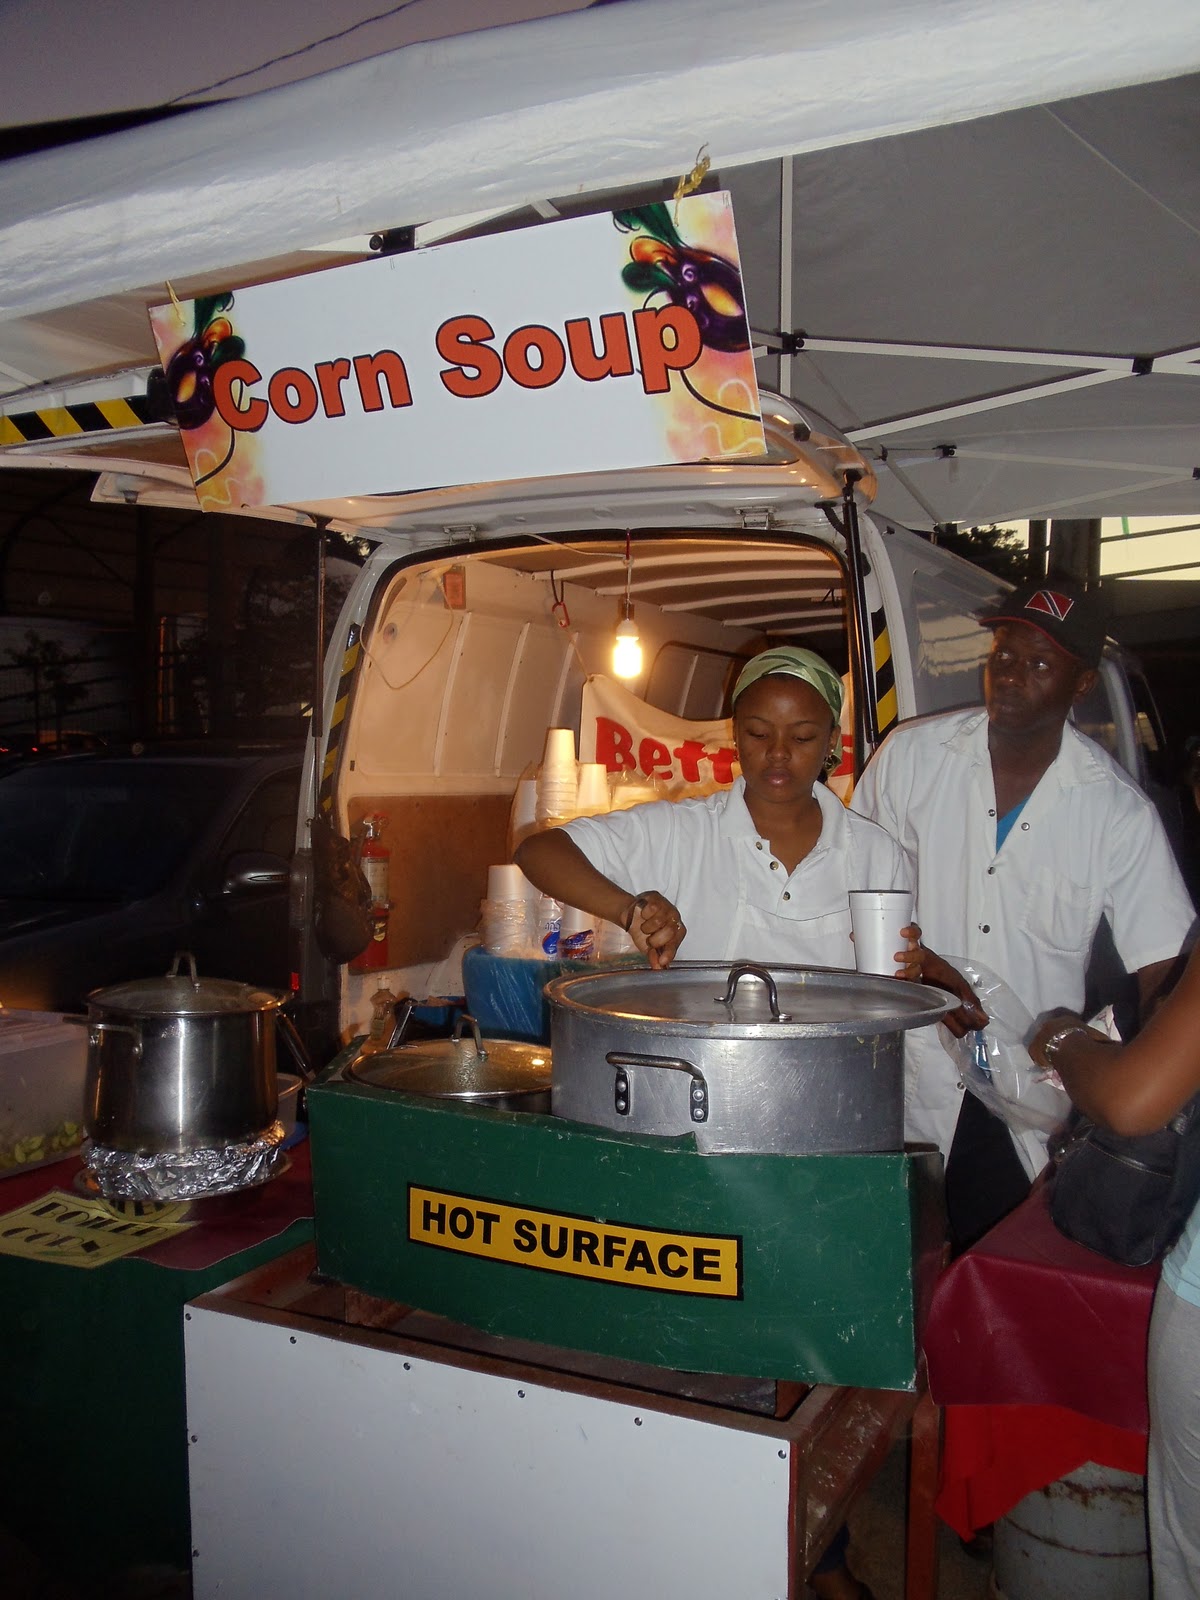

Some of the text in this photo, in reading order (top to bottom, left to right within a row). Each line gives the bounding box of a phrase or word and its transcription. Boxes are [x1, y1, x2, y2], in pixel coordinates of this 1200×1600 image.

[212, 303, 702, 433] Corn Soup
[595, 716, 739, 783] Bett
[30, 1202, 168, 1236] BOILED
[422, 1199, 721, 1282] HOT SURFACE
